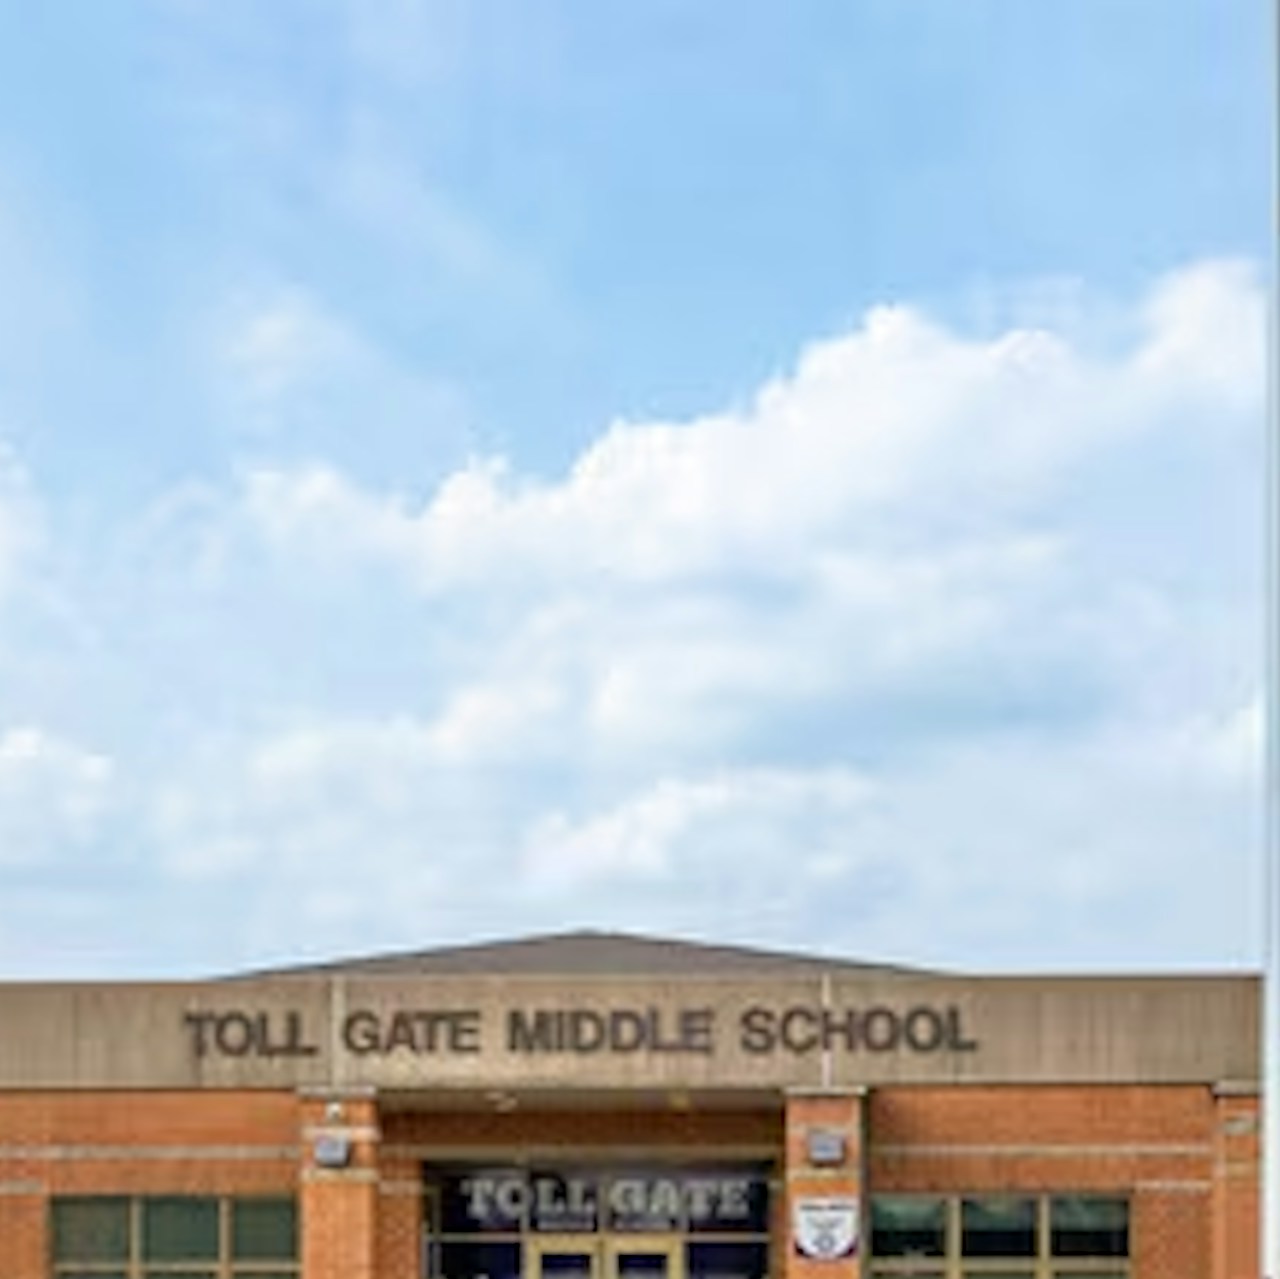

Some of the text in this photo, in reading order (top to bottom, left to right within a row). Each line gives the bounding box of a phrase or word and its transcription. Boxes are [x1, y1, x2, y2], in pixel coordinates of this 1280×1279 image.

[183, 1005, 978, 1057] TOLL GATE MIDDLE SCHOOL
[459, 1177, 749, 1222] TOLL GATE
